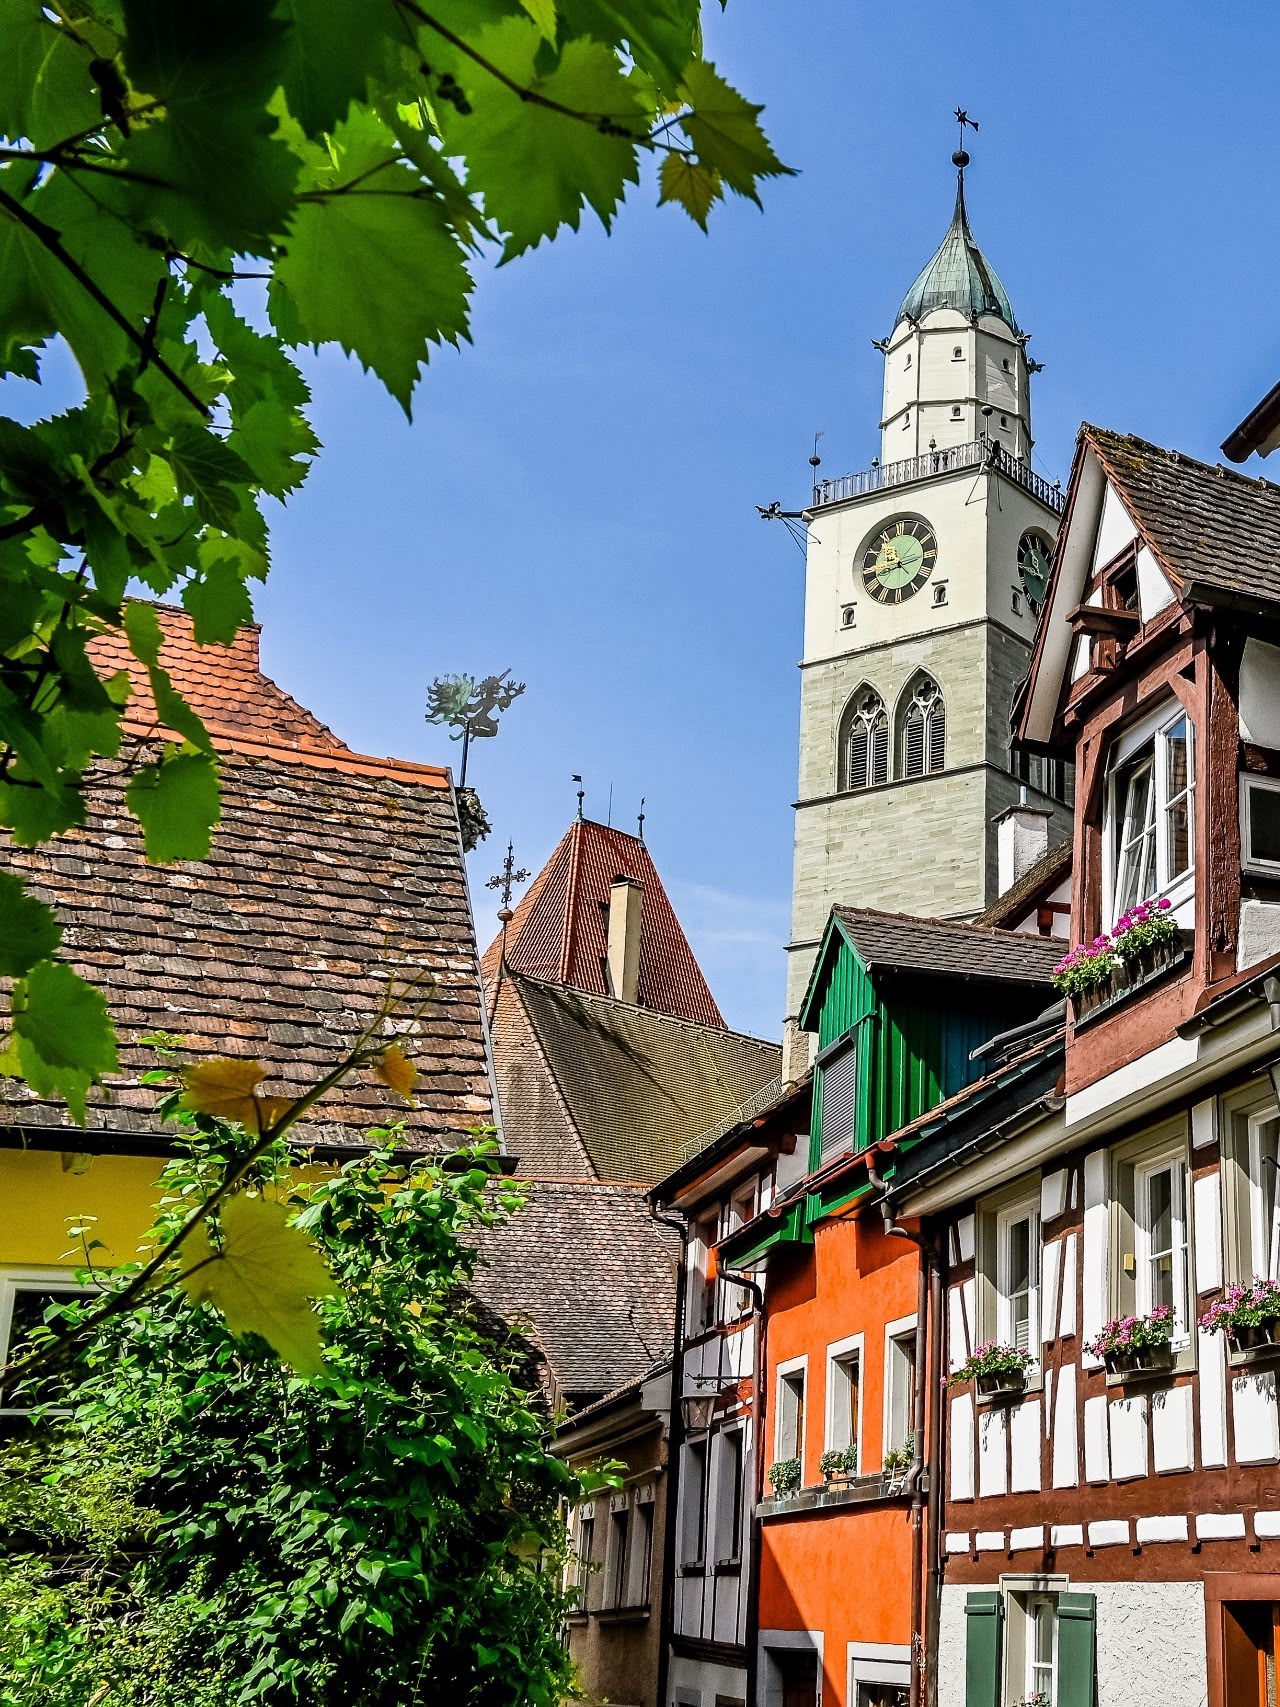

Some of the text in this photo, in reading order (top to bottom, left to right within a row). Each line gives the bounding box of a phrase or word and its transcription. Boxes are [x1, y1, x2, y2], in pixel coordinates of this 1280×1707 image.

[911, 522, 919, 536] I
[920, 532, 931, 545] II
[867, 547, 880, 559] X
[923, 550, 936, 559] III
[910, 581, 919, 594] V
